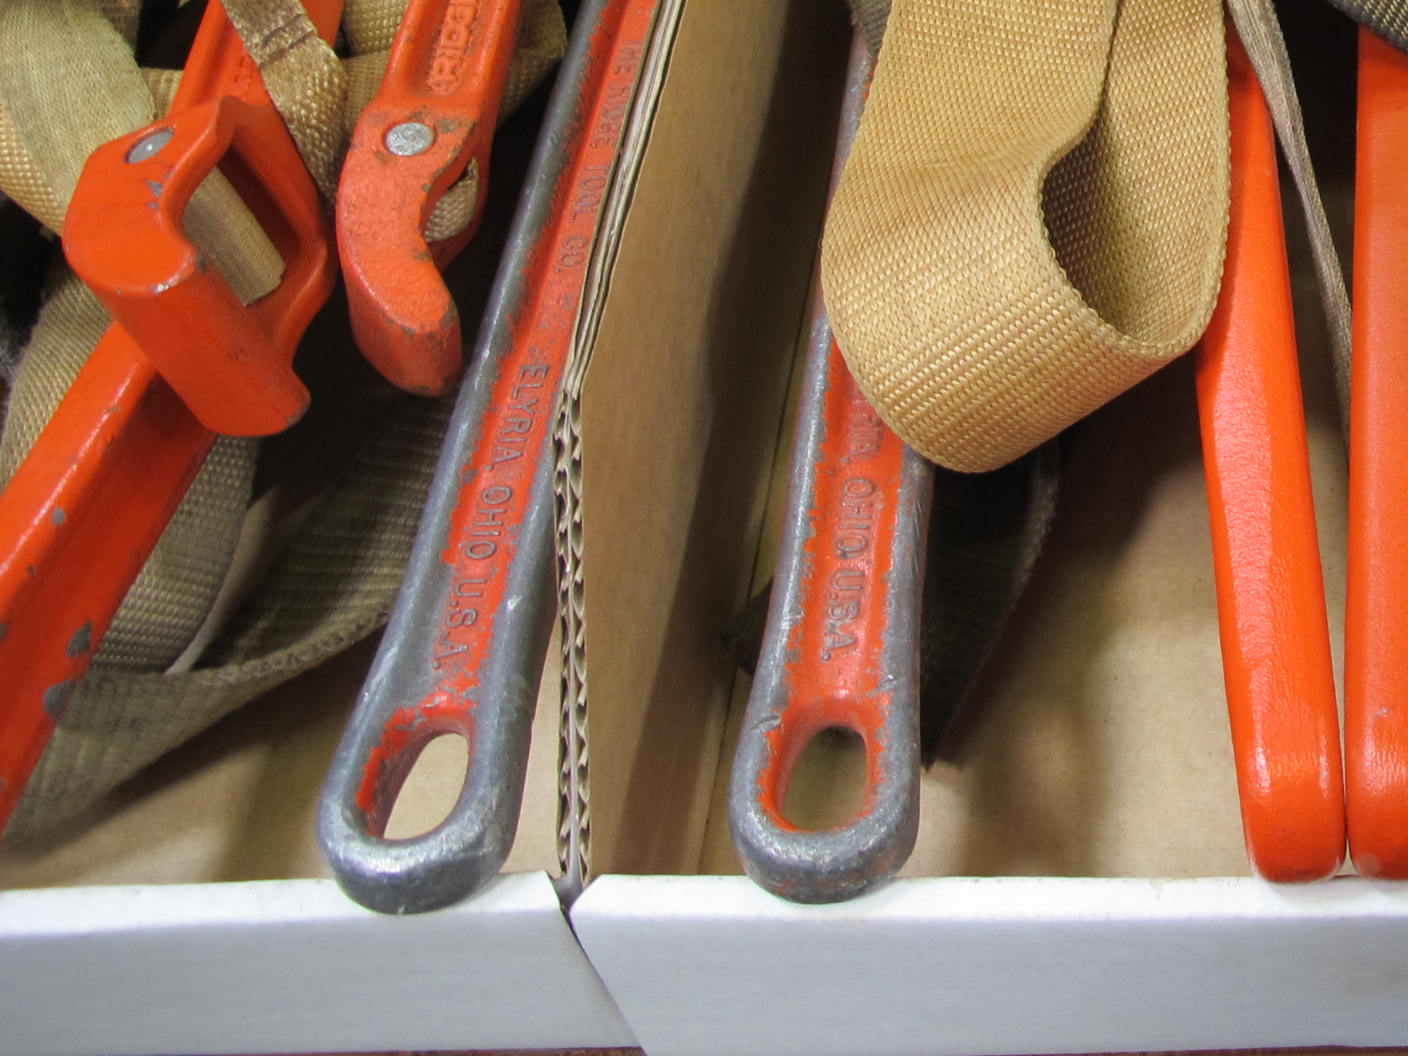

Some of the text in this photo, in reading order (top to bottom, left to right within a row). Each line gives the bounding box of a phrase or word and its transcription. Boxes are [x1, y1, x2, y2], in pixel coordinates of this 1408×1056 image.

[465, 485, 513, 560] OHIO
[835, 476, 876, 560] OHIO
[431, 577, 487, 670] U.S.A.
